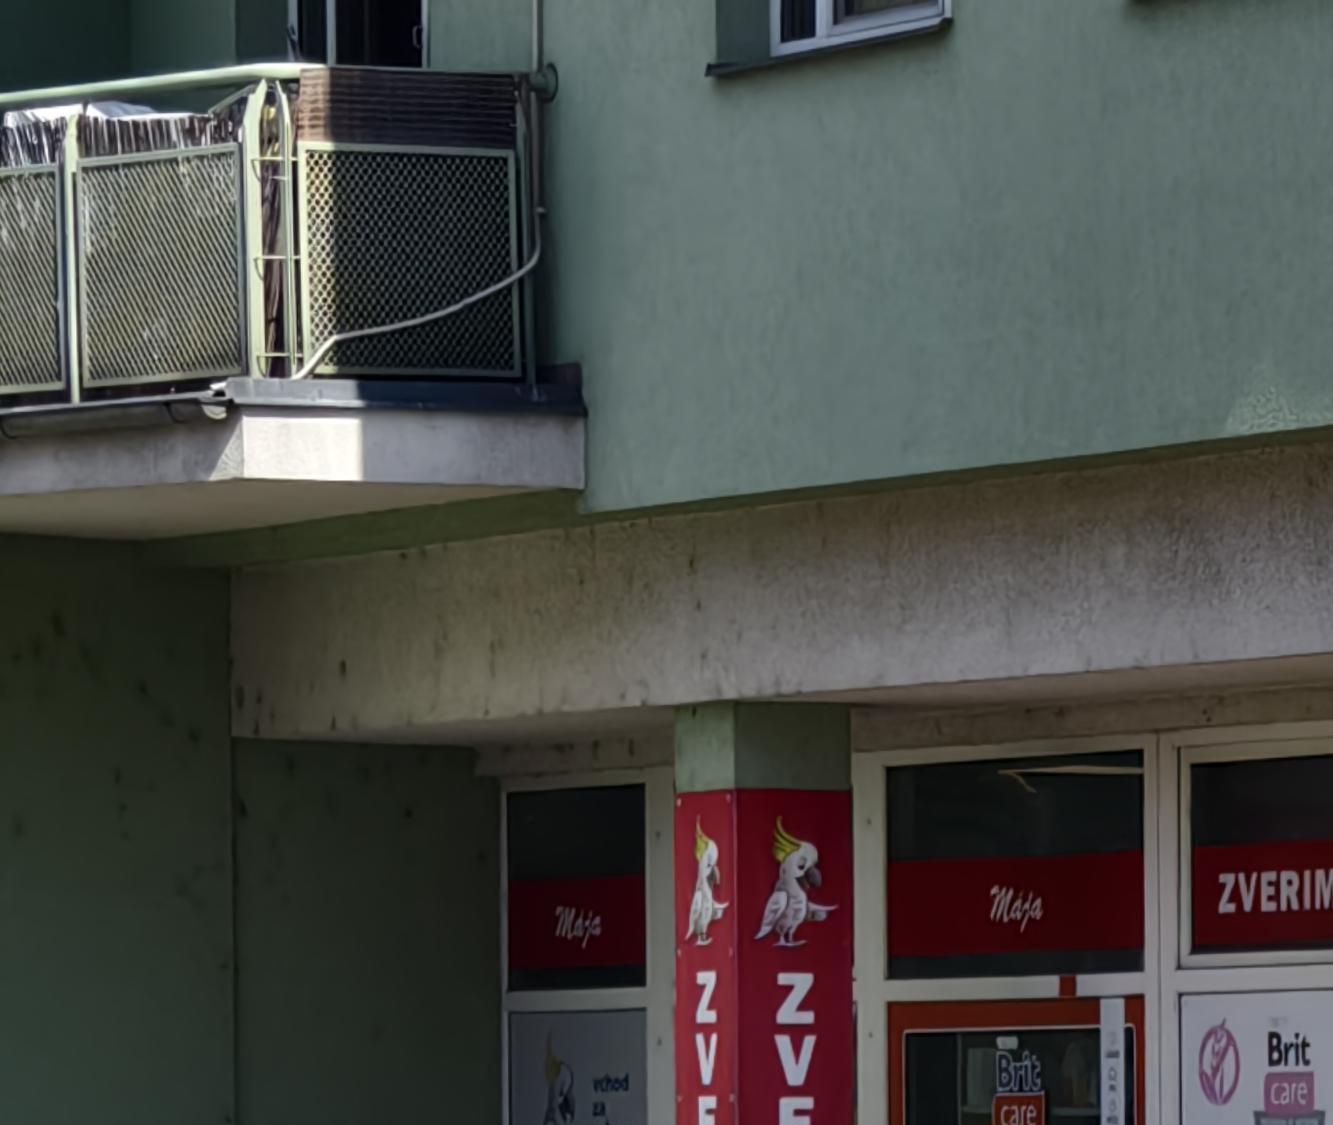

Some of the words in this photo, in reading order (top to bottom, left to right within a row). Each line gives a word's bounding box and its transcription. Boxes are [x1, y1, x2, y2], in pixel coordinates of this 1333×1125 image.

[989, 884, 1043, 933] Mája
[1267, 1031, 1311, 1067] Brit
[593, 1073, 629, 1092] vchod
[996, 1051, 1041, 1091] Brit
[1271, 1081, 1308, 1105] care
